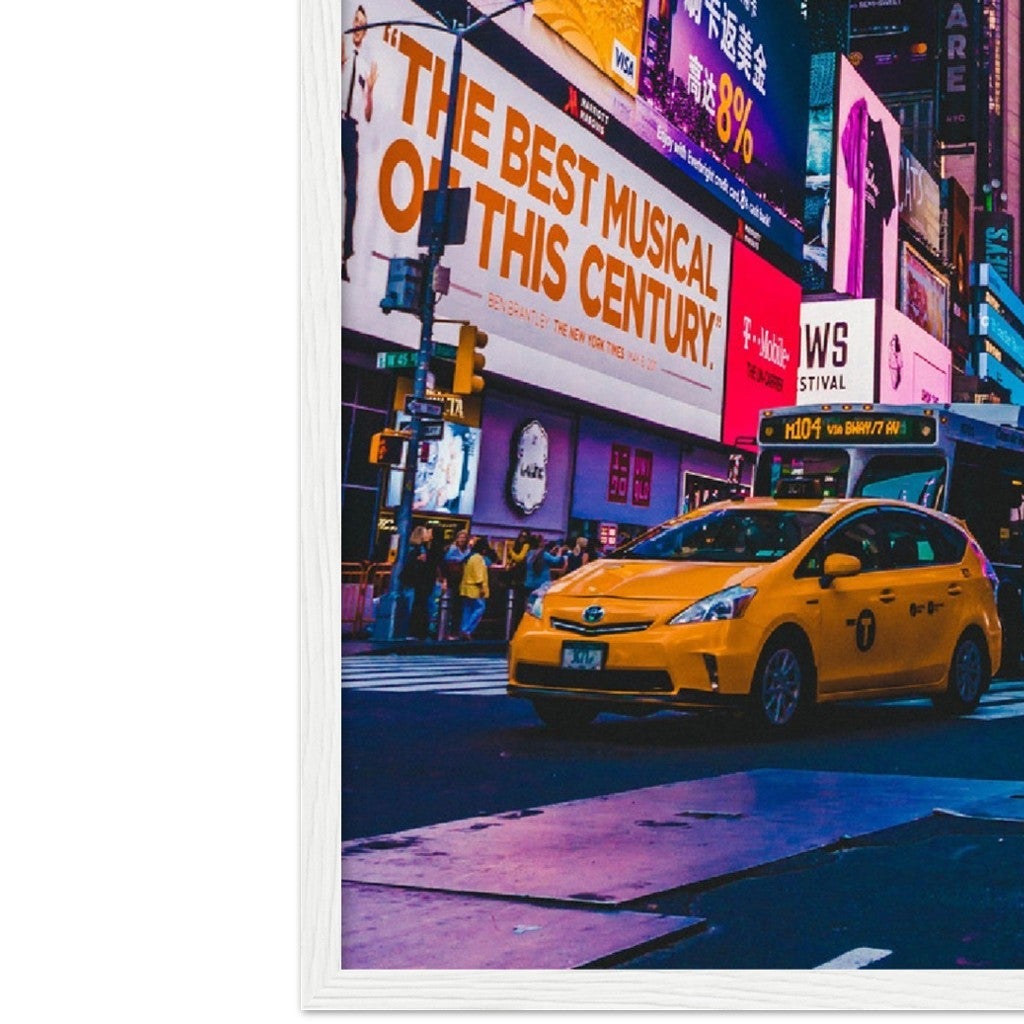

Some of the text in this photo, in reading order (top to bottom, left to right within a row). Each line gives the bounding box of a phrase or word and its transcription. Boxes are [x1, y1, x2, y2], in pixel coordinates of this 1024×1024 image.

[615, 46, 634, 79] VISA
[716, 72, 754, 165] 8%
[500, 105, 599, 227] BEST
[602, 173, 718, 301] MUSICAL
[475, 181, 569, 302] THIS
[800, 321, 848, 369] WS
[797, 373, 846, 392] STIVAL
[785, 417, 821, 439] M104
[886, 421, 900, 435] AV
